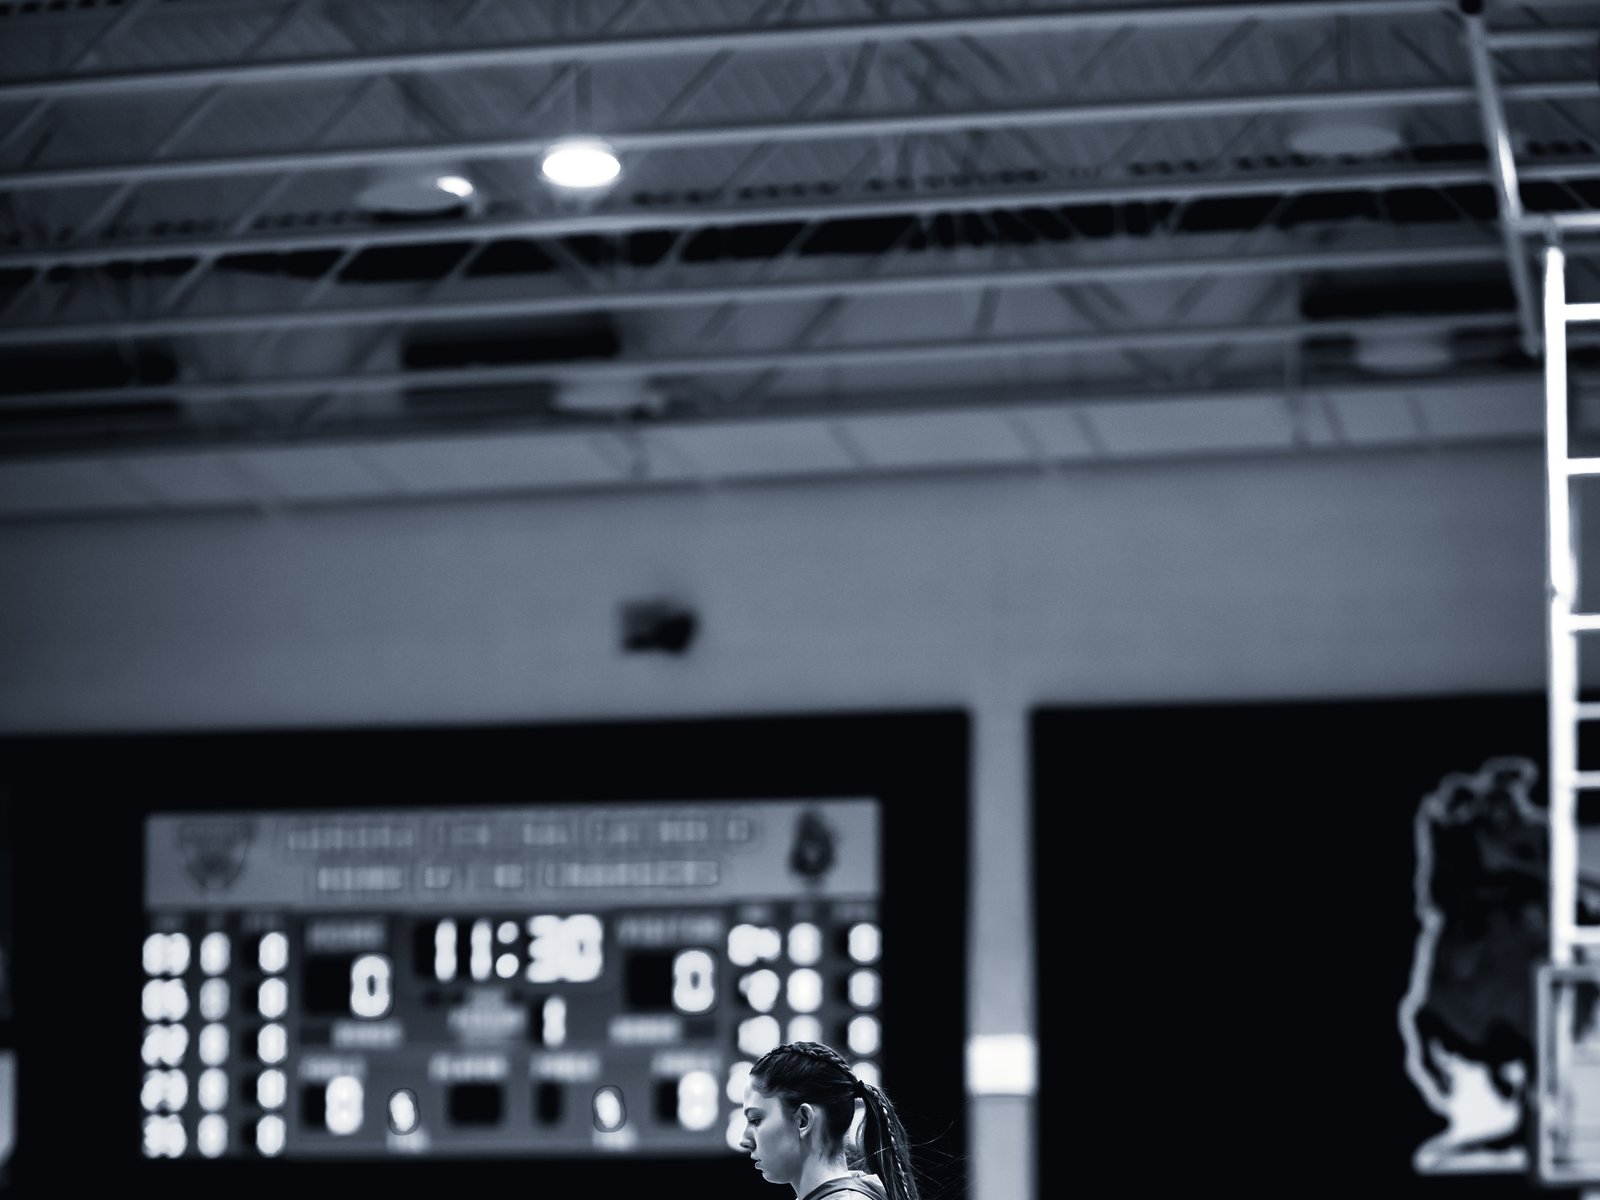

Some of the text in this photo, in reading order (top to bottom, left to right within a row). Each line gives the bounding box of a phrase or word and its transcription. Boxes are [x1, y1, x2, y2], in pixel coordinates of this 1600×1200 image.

[434, 915, 603, 983] 11:30
[350, 956, 390, 1017] 0
[673, 950, 714, 1012] 0
[543, 998, 567, 1048] 1
